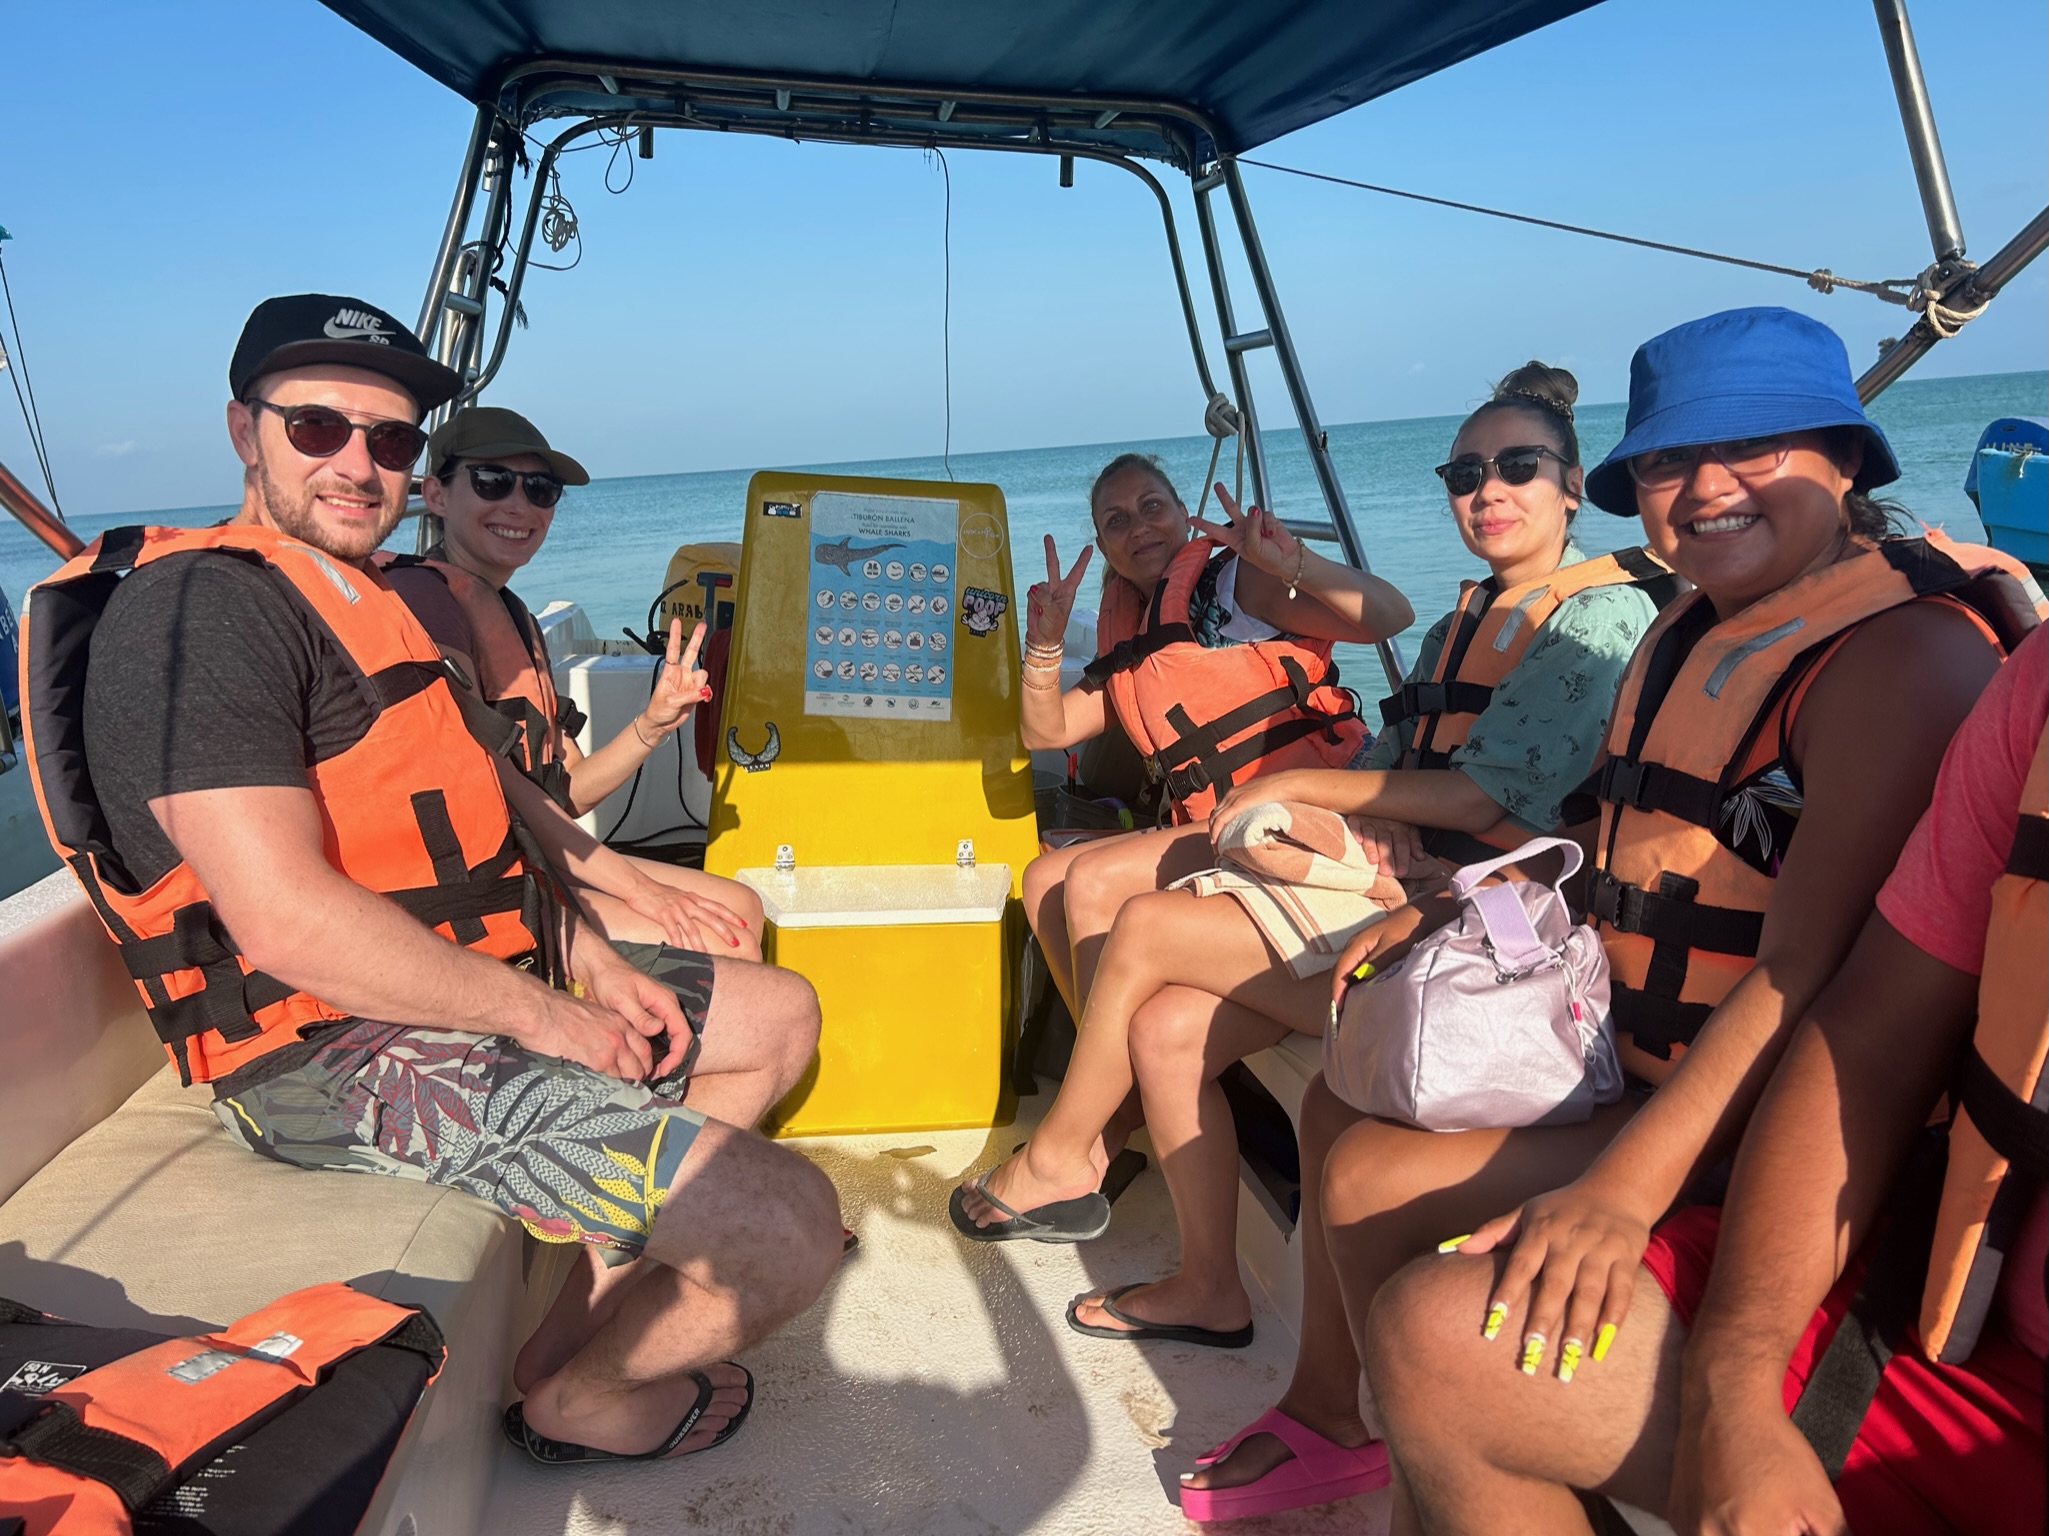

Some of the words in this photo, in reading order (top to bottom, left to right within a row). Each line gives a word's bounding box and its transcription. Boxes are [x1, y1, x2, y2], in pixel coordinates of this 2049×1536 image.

[335, 308, 382, 331] NIKE
[858, 528, 882, 536] WHALE
[884, 529, 911, 538] SHARKS
[963, 594, 1006, 617] POOP
[669, 1407, 701, 1449] QUIKSILVER
